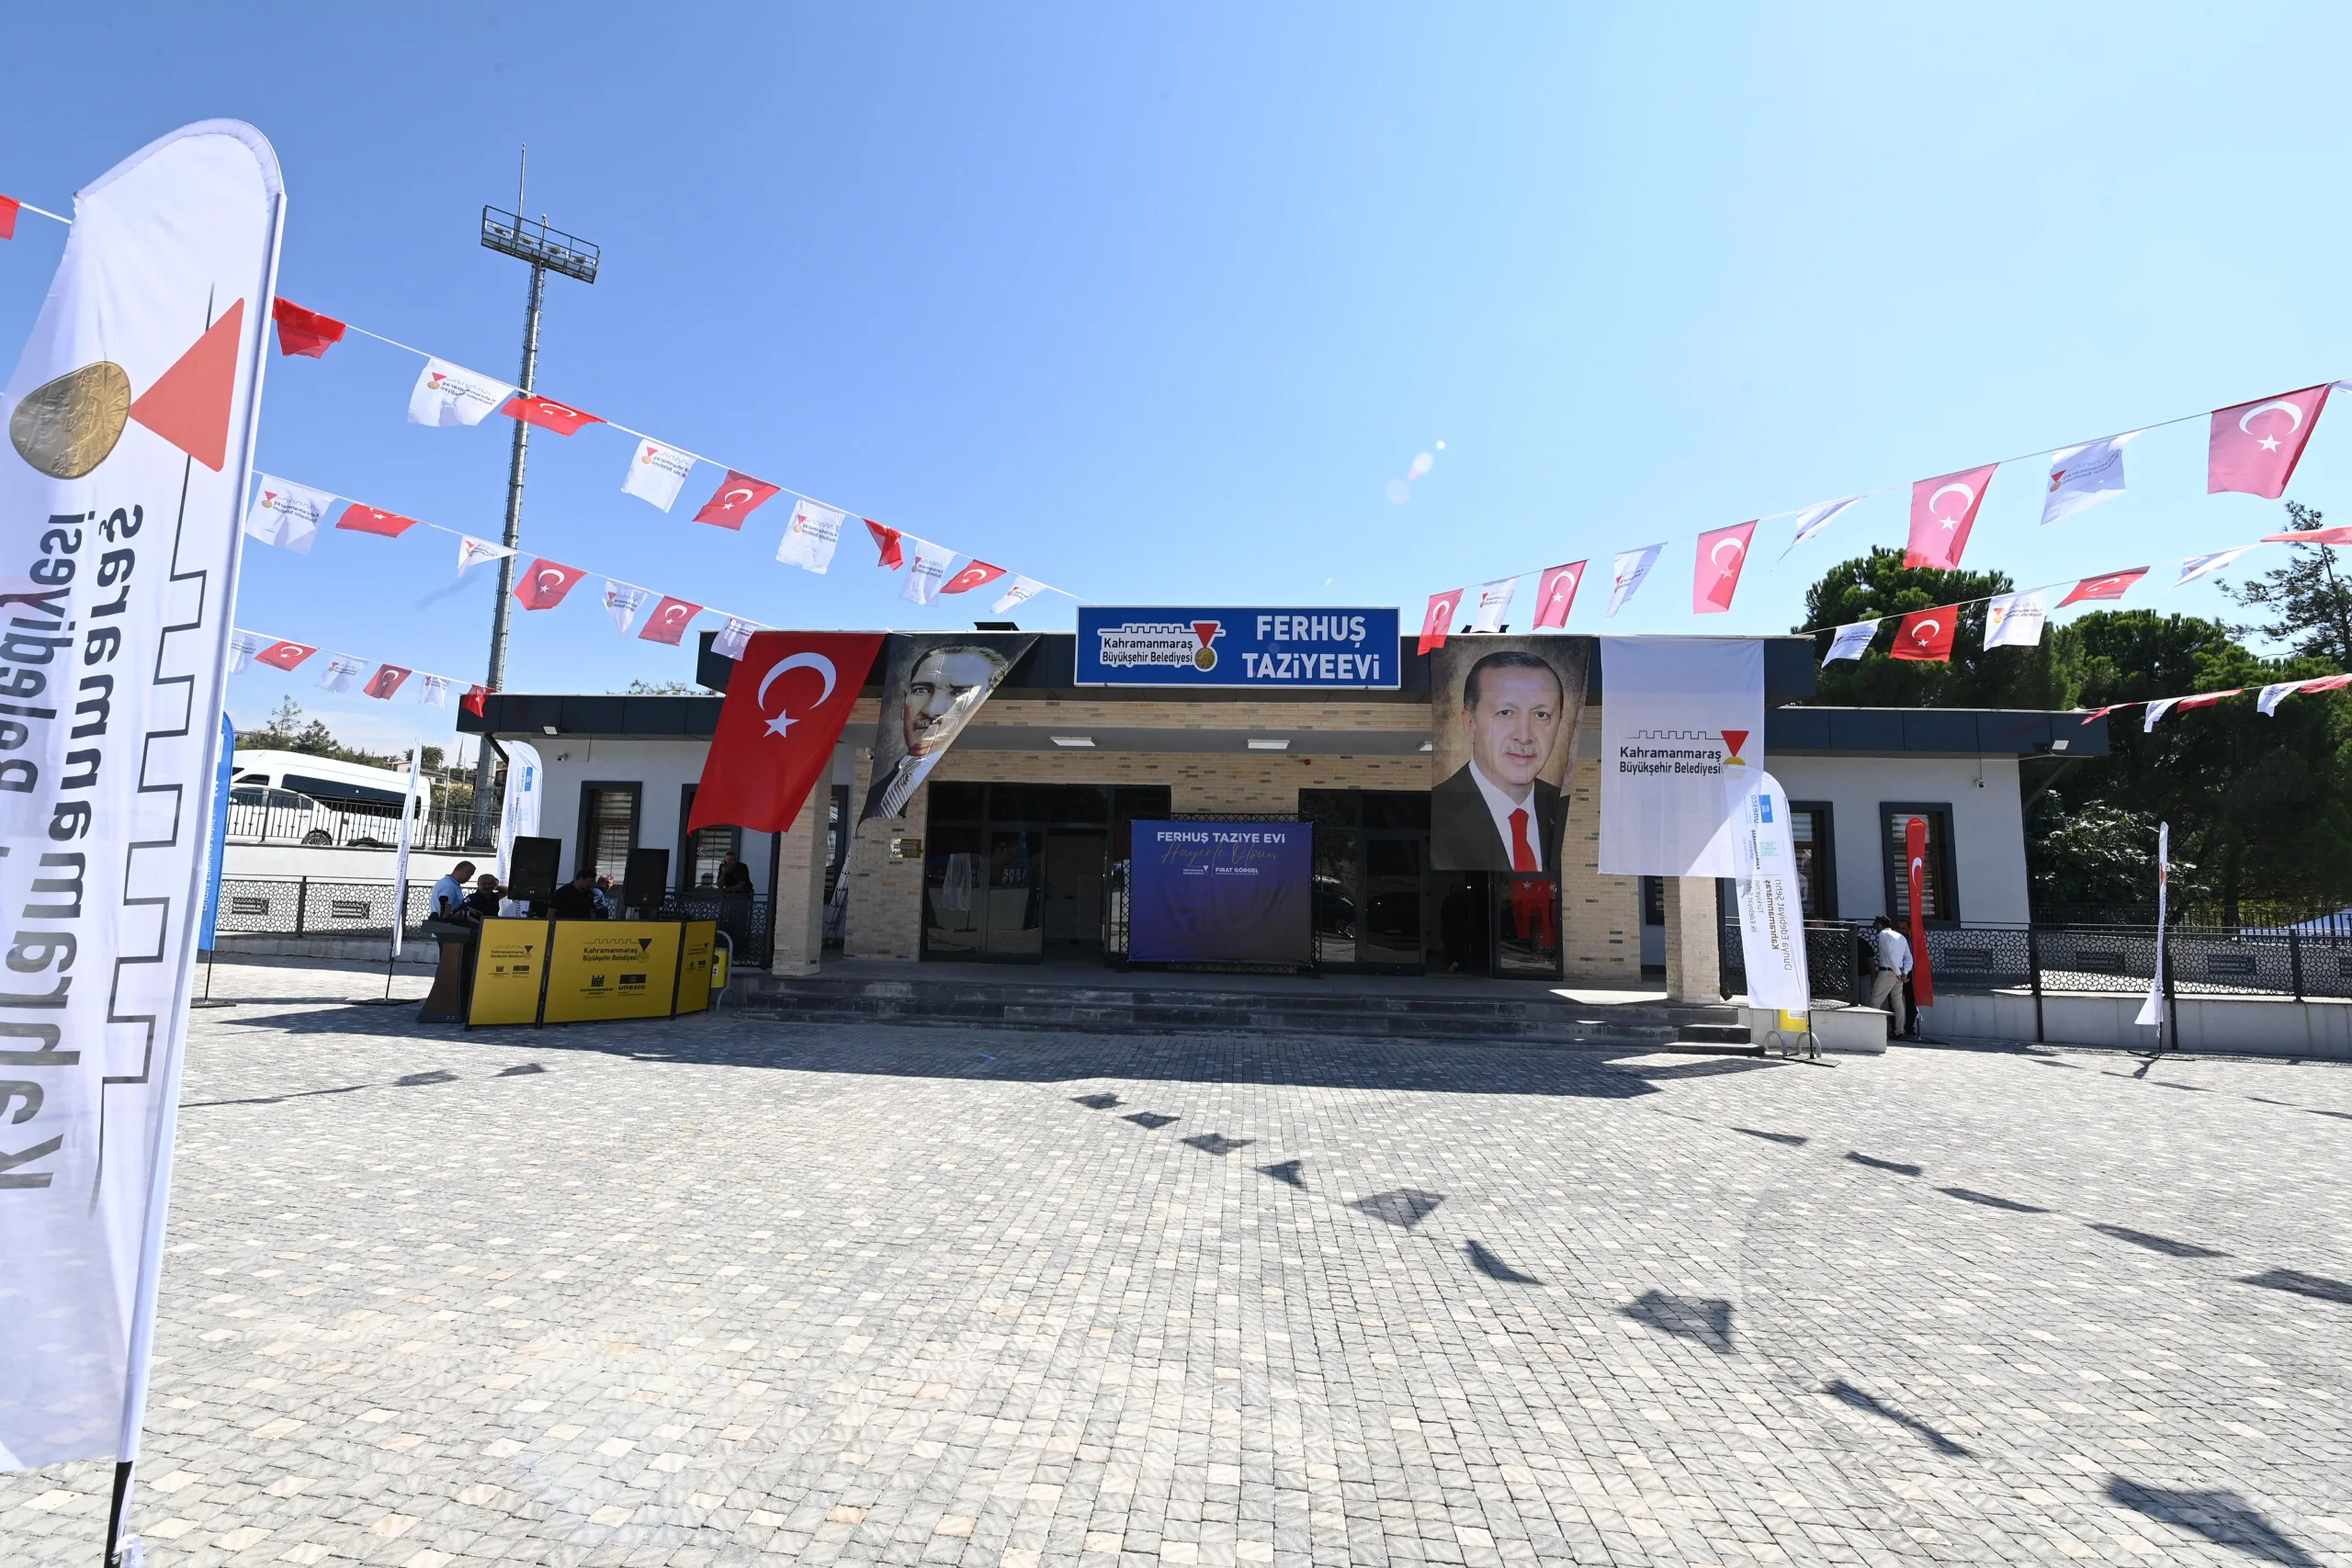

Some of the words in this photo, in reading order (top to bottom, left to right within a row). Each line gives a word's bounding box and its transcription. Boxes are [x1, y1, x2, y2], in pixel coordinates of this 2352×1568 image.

[1256, 615, 1366, 648] FERHUŞ
[1103, 637, 1193, 651] Kahramanmaraş
[1102, 651, 1148, 665] Büyükşehir
[1150, 651, 1193, 665] Belediyesi
[1620, 746, 1722, 762] Kahramanmaraş
[1620, 761, 1672, 775] Büyükşehir
[1674, 762, 1721, 776] Belediyesi
[1157, 831, 1209, 844] FERHUŞ
